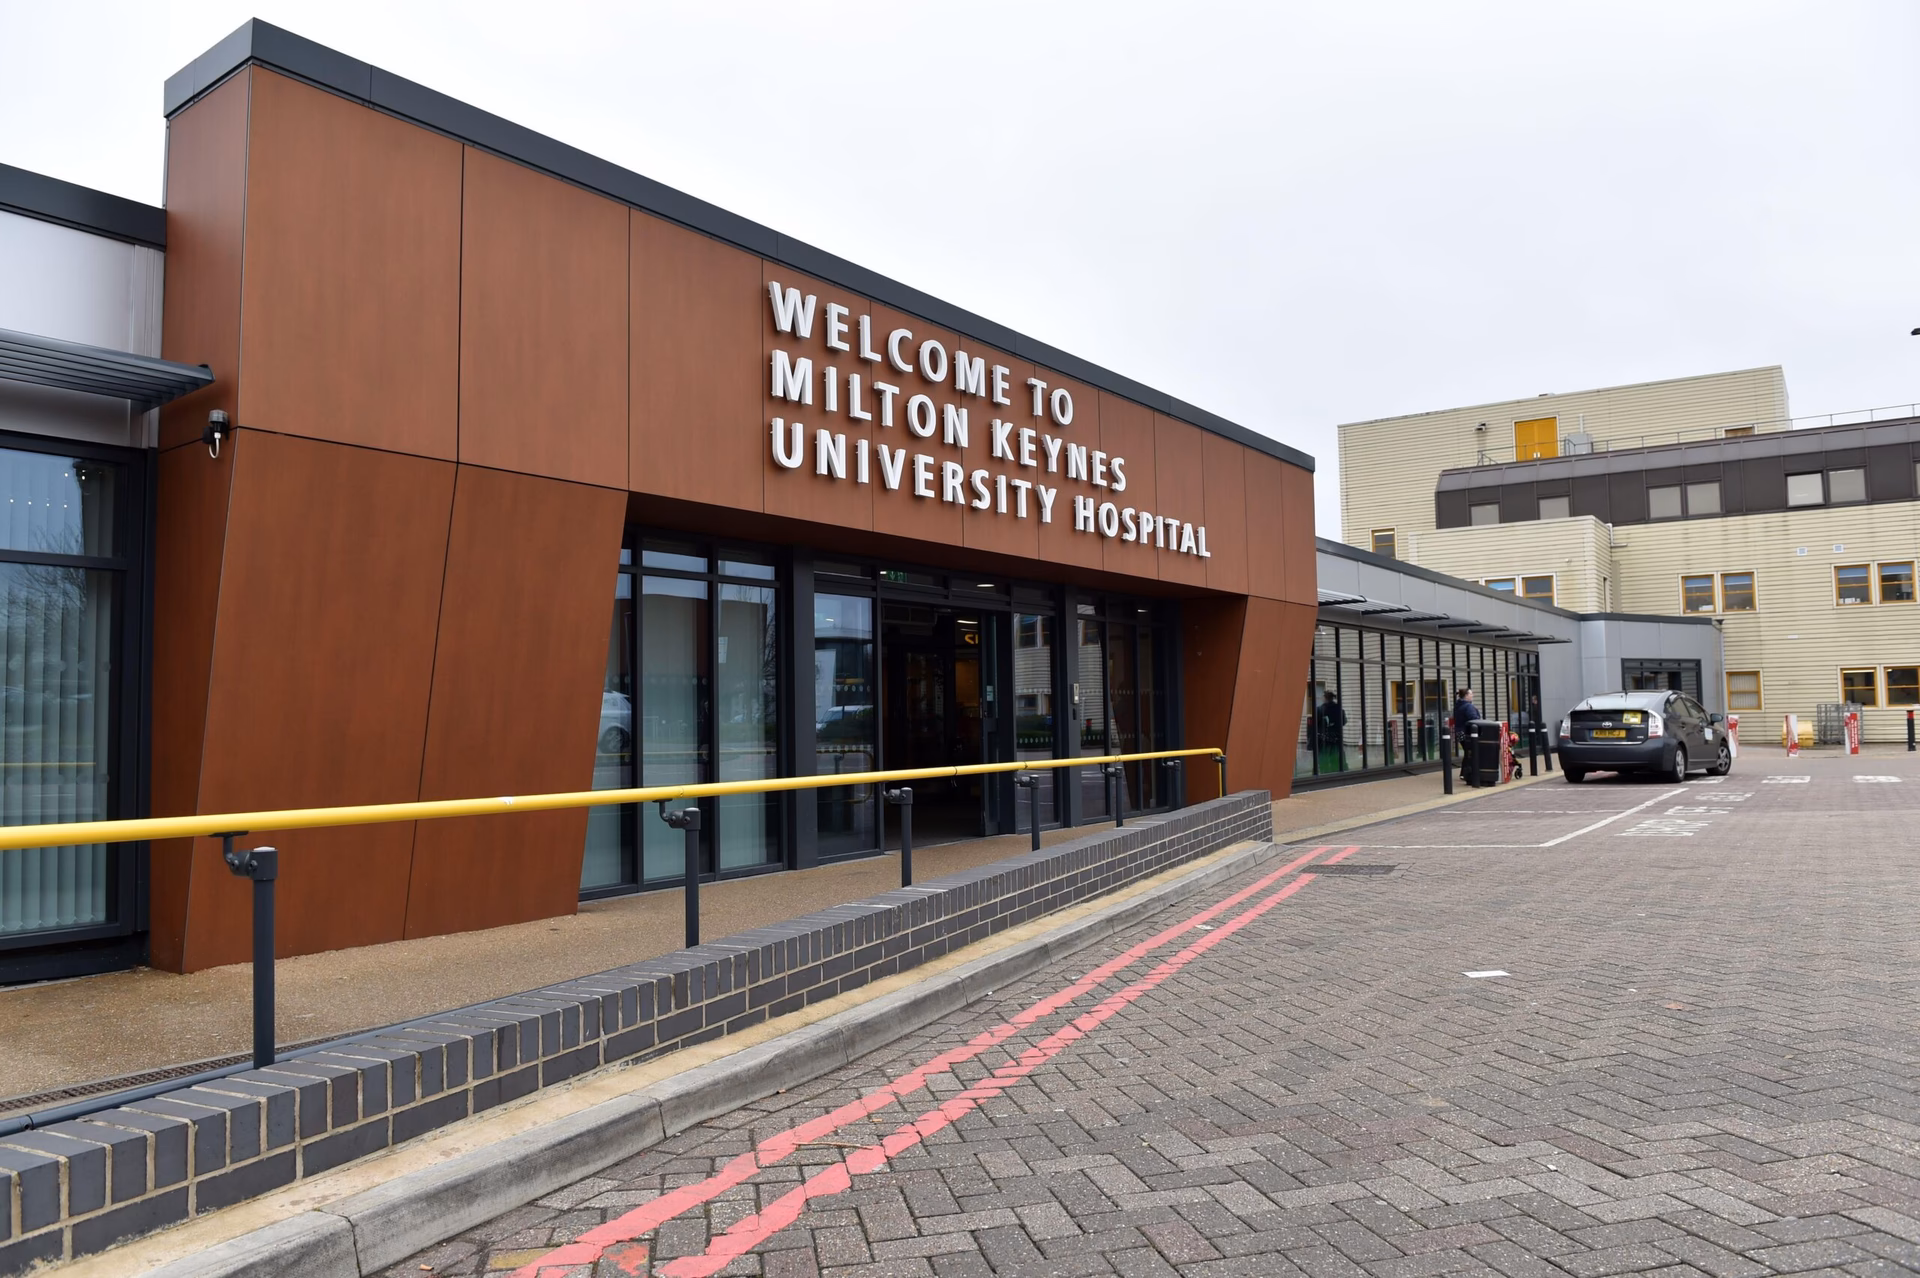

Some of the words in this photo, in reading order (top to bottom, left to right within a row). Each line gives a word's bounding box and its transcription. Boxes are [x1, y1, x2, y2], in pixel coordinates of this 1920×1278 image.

[767, 280, 1012, 406] WELCOME
[1026, 377, 1074, 426] TO
[770, 349, 969, 448] MILTON
[991, 418, 1127, 492] KEYNES
[769, 416, 1058, 523] UNIVERSITY
[1073, 494, 1212, 558] HOSPITAL
